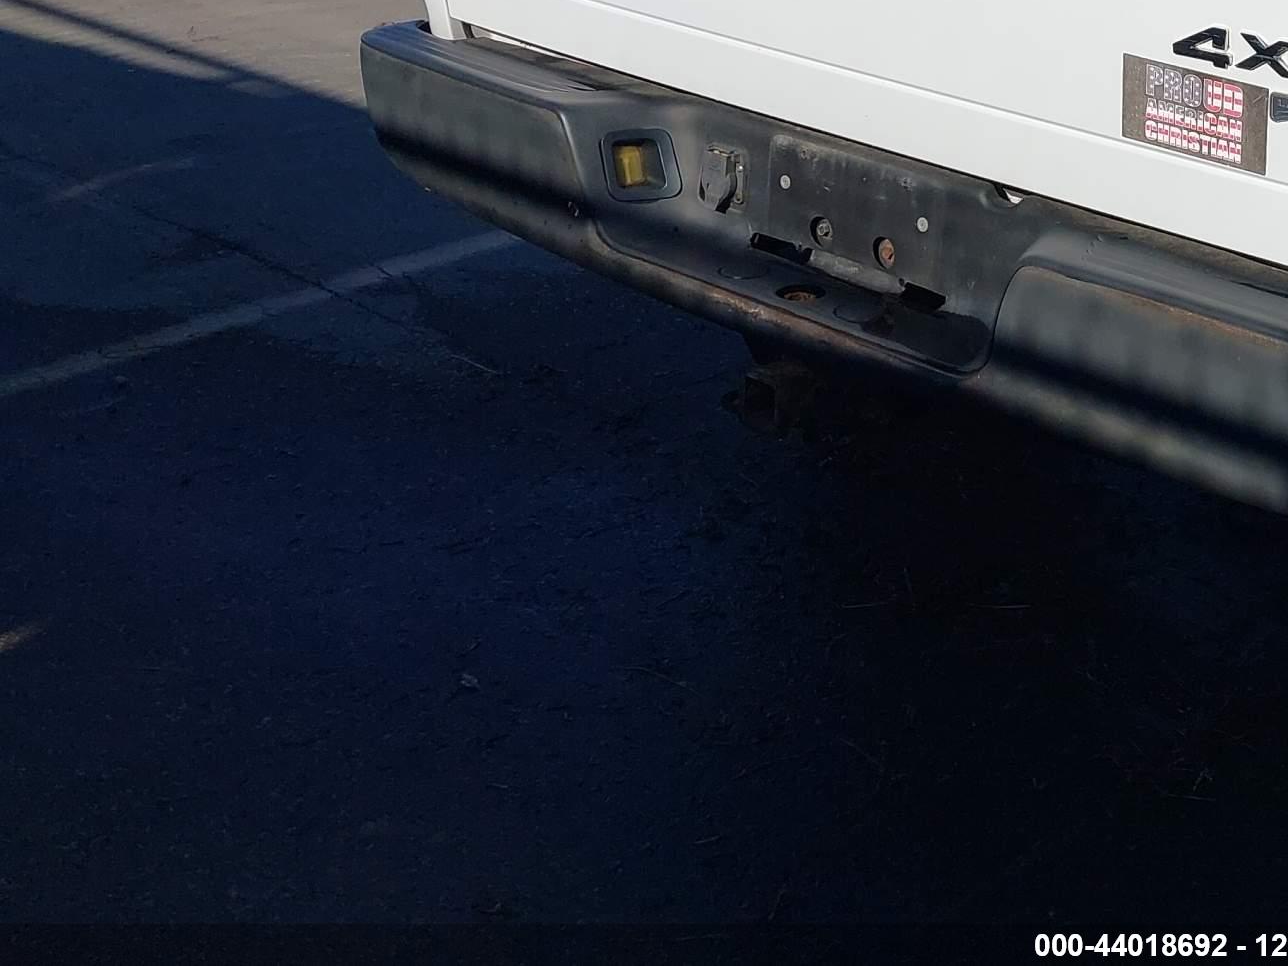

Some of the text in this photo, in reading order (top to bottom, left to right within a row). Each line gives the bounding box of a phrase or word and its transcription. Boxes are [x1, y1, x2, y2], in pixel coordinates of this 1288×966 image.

[1145, 63, 1244, 119] PROUD
[1144, 120, 1242, 165] CHRISTIAN
[1145, 98, 1243, 142] AMERICAN
